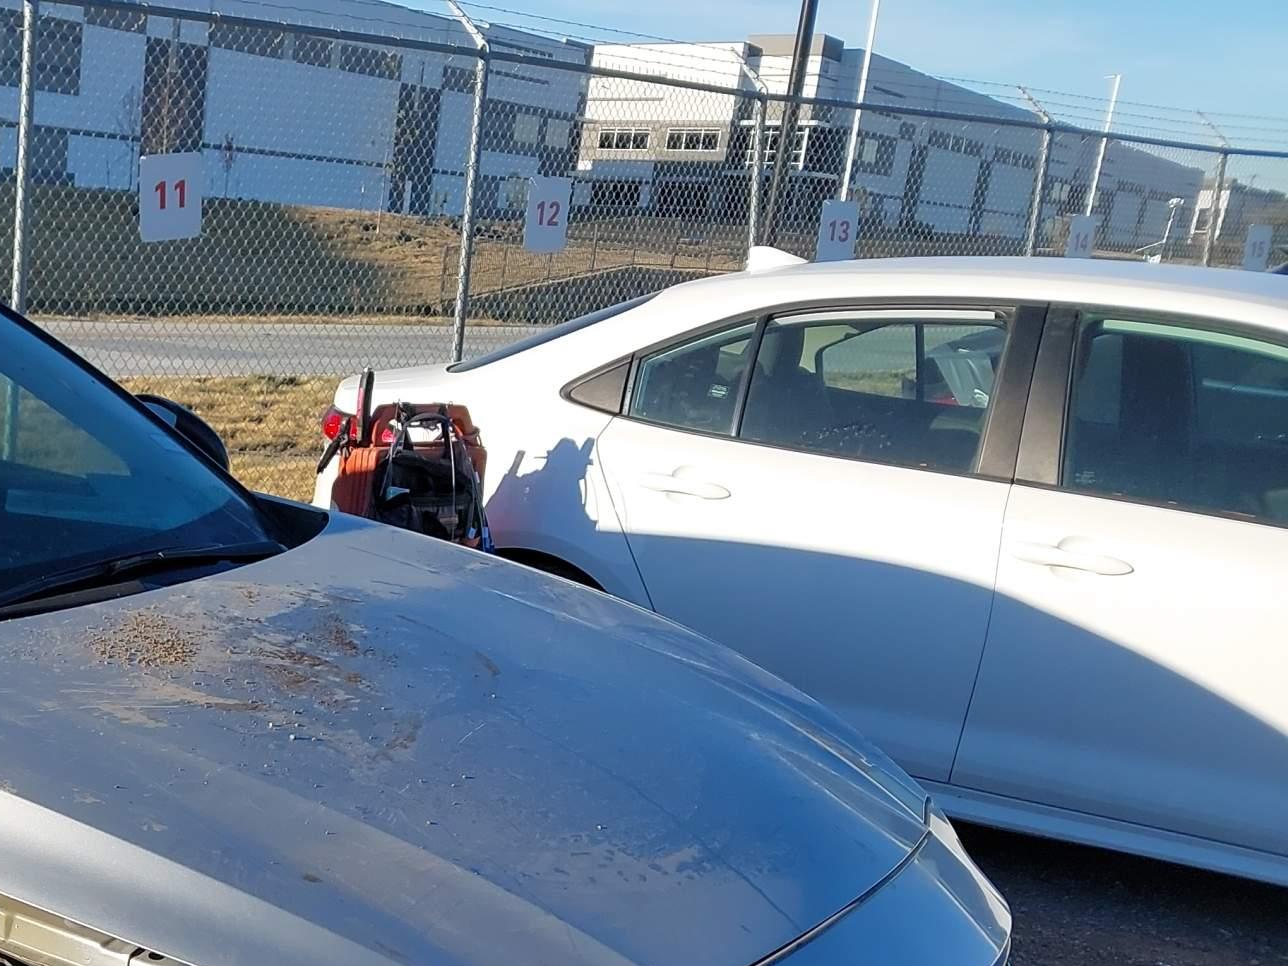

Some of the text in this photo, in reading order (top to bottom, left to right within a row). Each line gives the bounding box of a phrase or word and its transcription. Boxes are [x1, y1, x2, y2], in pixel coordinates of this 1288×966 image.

[154, 179, 186, 210] 11
[536, 200, 561, 227] 12
[829, 220, 851, 242] 13
